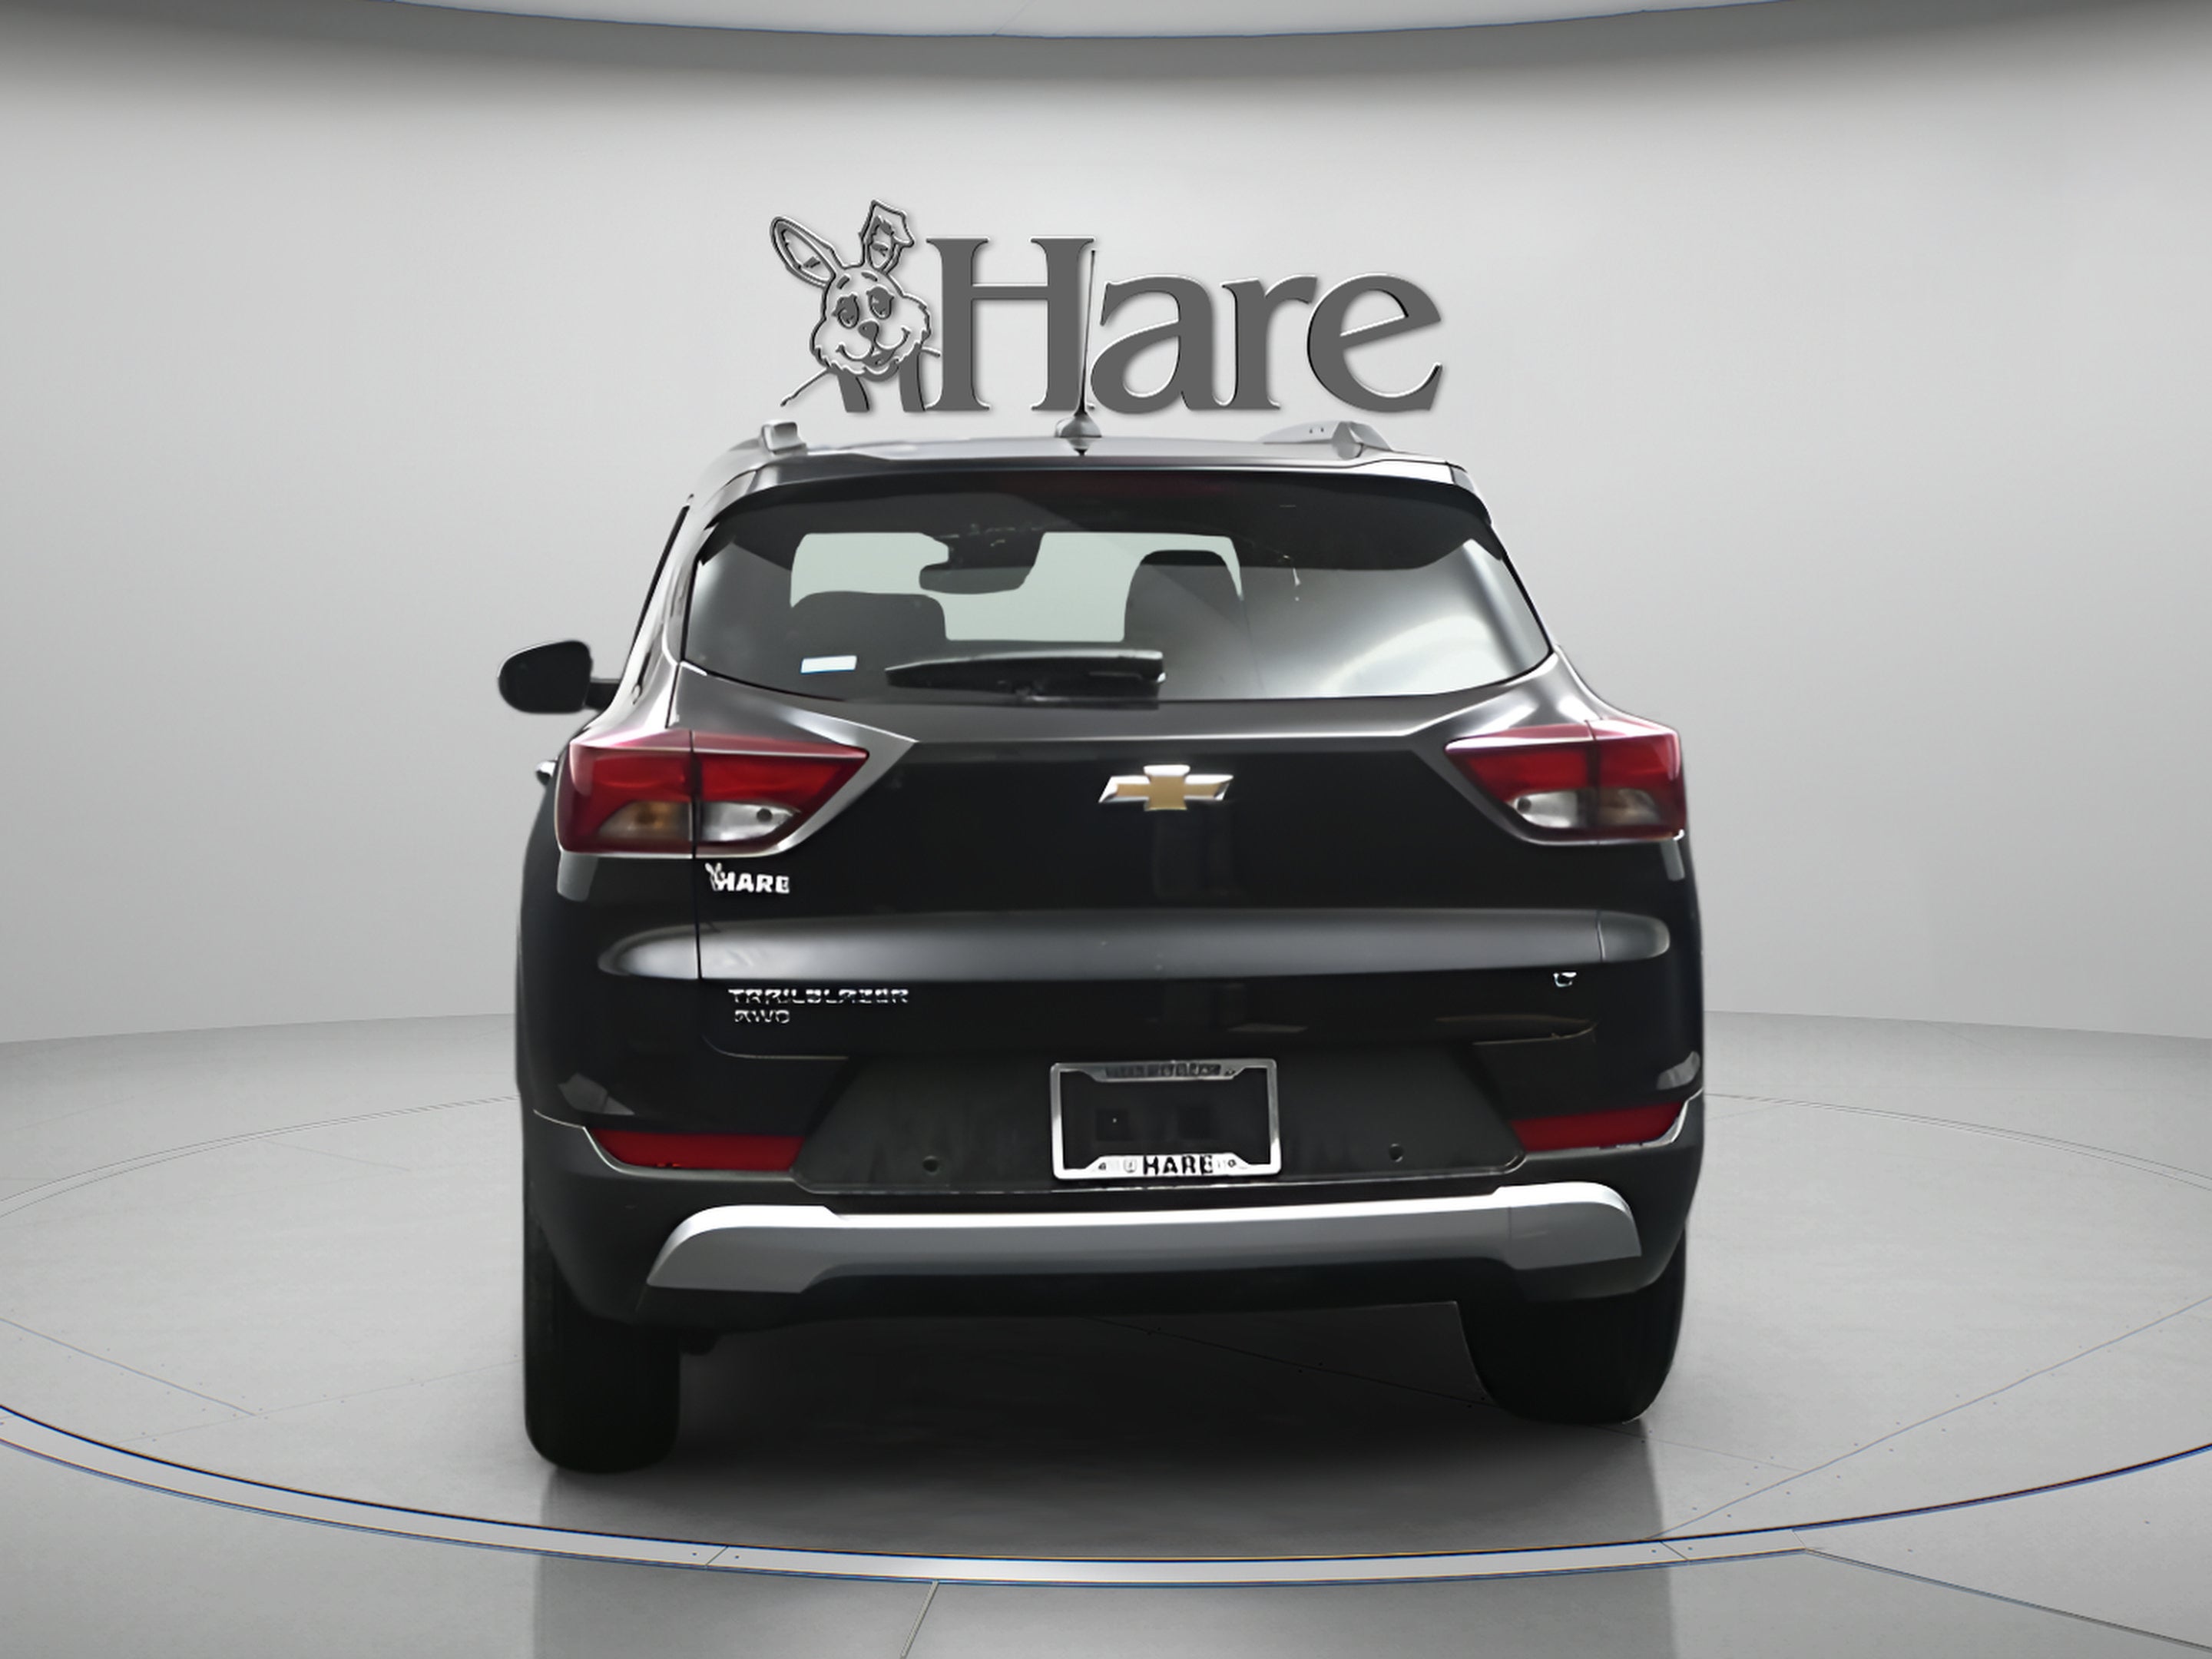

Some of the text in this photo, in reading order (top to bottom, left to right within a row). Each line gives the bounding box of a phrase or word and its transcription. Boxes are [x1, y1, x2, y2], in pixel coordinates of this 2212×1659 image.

[925, 237, 1443, 414] Hare
[717, 871, 790, 893] HARE
[1143, 1154, 1214, 1175] HARE
